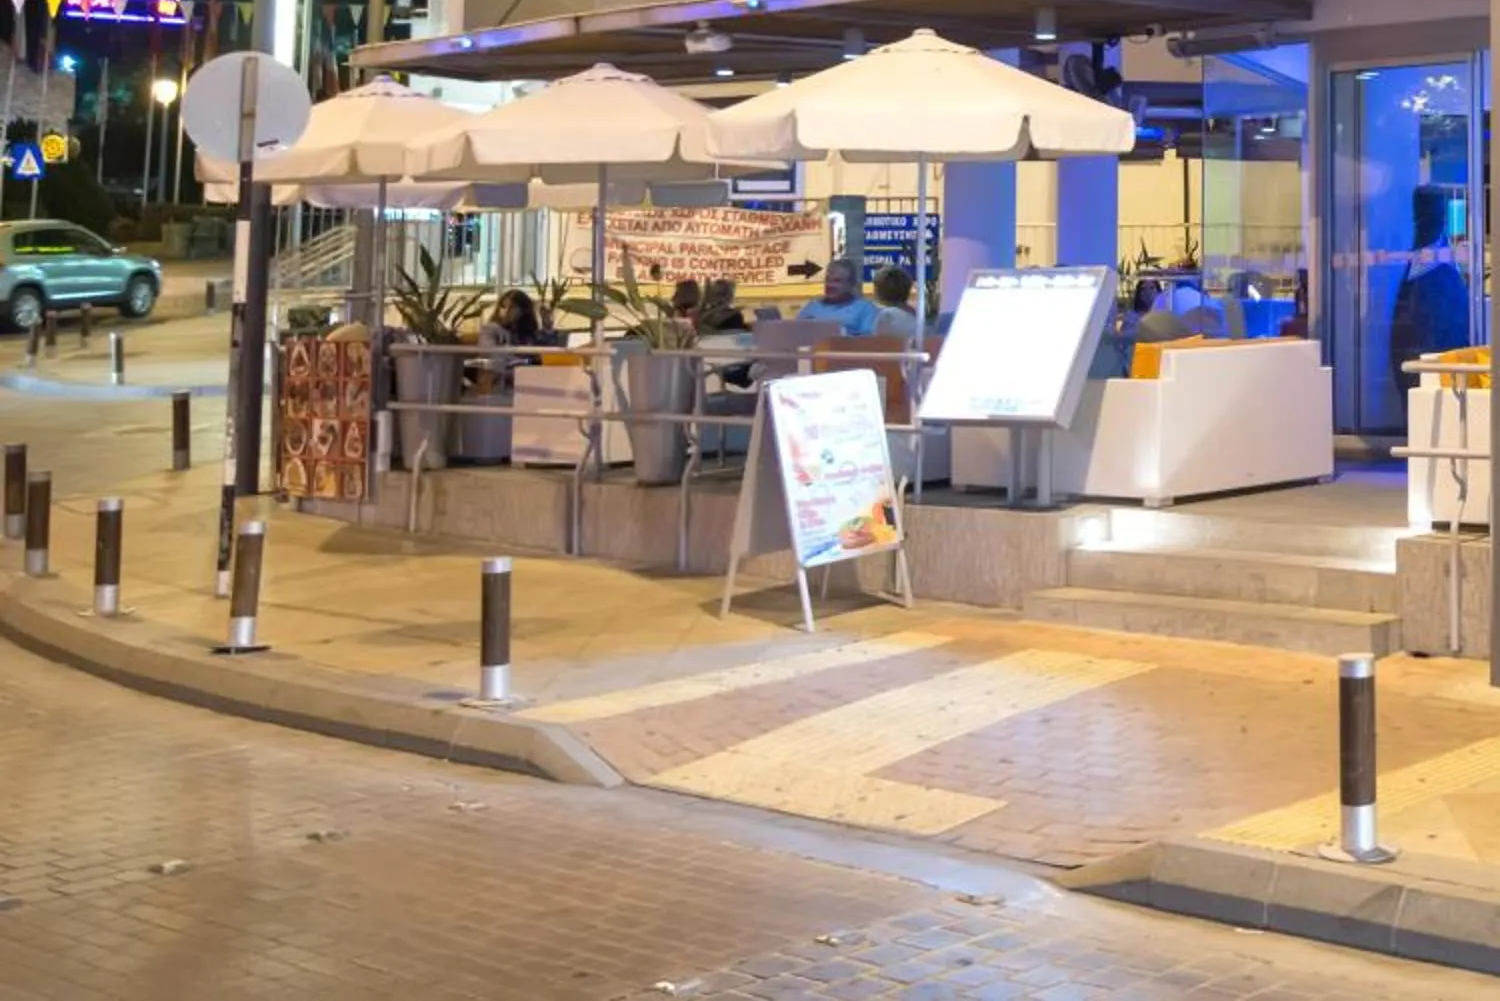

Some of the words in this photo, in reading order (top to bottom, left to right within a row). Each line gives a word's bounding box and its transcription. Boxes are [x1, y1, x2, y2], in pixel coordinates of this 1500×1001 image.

[606, 238, 673, 253] MICIPAL
[679, 242, 741, 256] PARKNG
[607, 251, 668, 268] PAING
[689, 255, 785, 270] CONTROLLED
